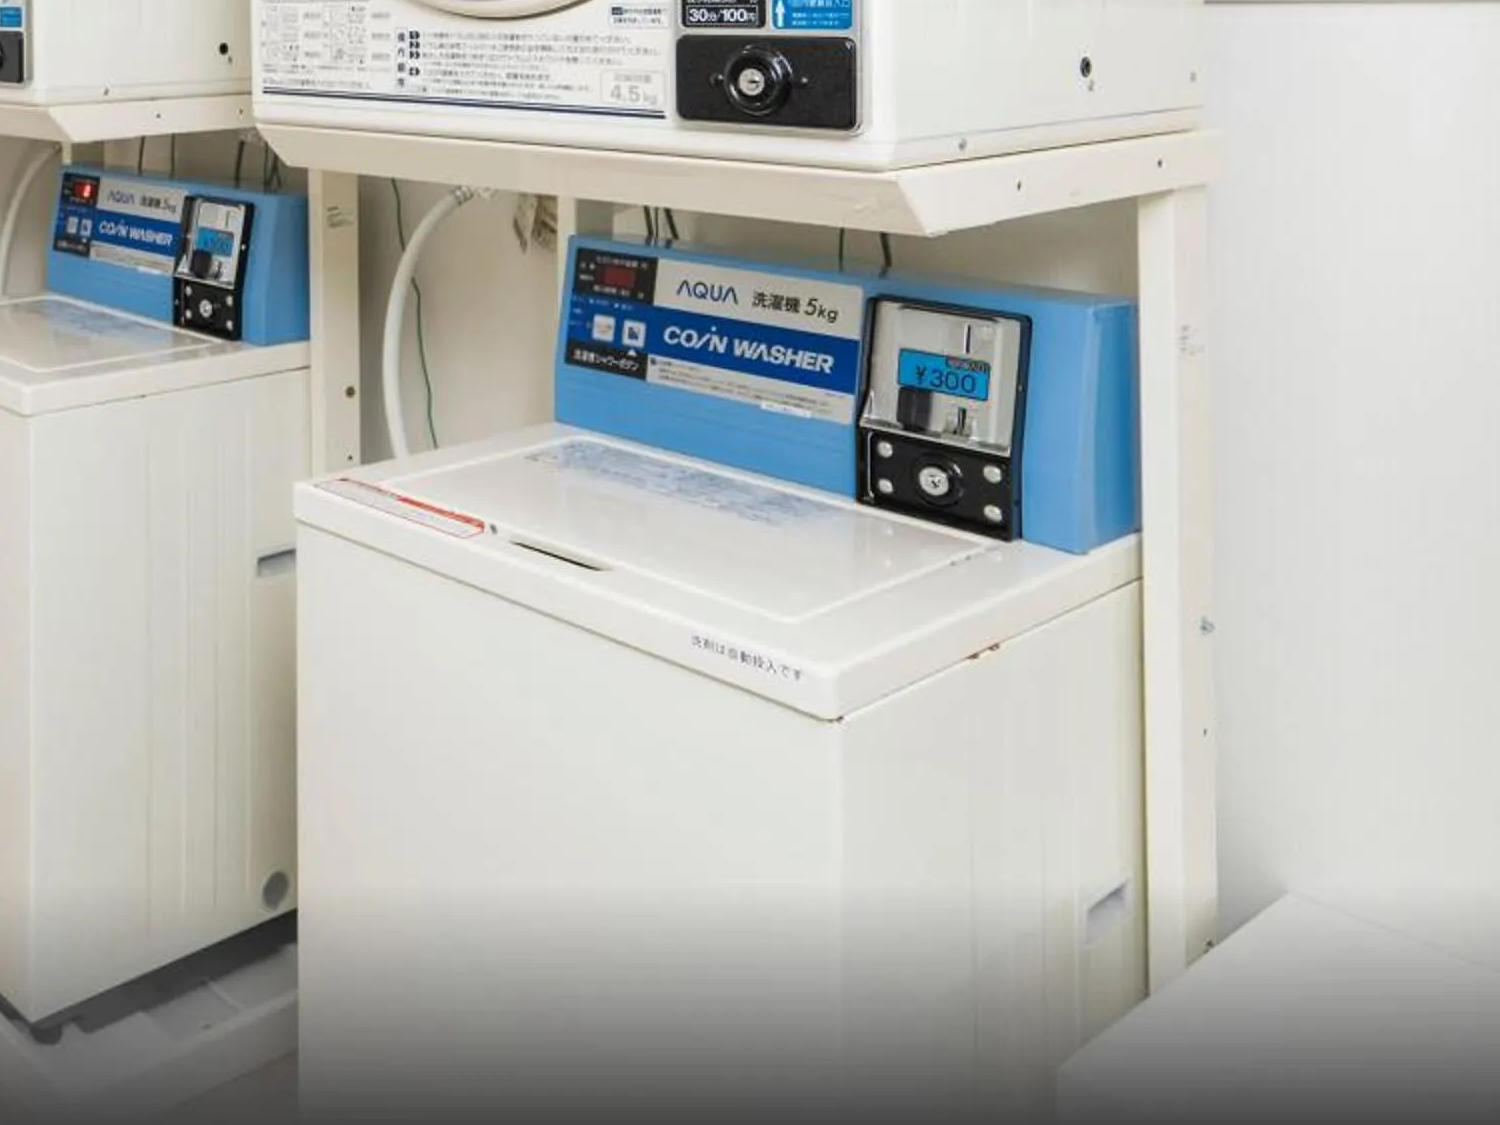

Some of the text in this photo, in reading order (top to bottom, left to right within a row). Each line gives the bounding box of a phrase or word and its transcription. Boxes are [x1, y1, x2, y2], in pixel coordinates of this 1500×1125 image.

[676, 279, 739, 306] AQUA
[752, 290, 801, 314] 洗濯機
[804, 297, 839, 324] 5kg
[732, 337, 835, 375] WASHER
[915, 363, 976, 394] ¥300
